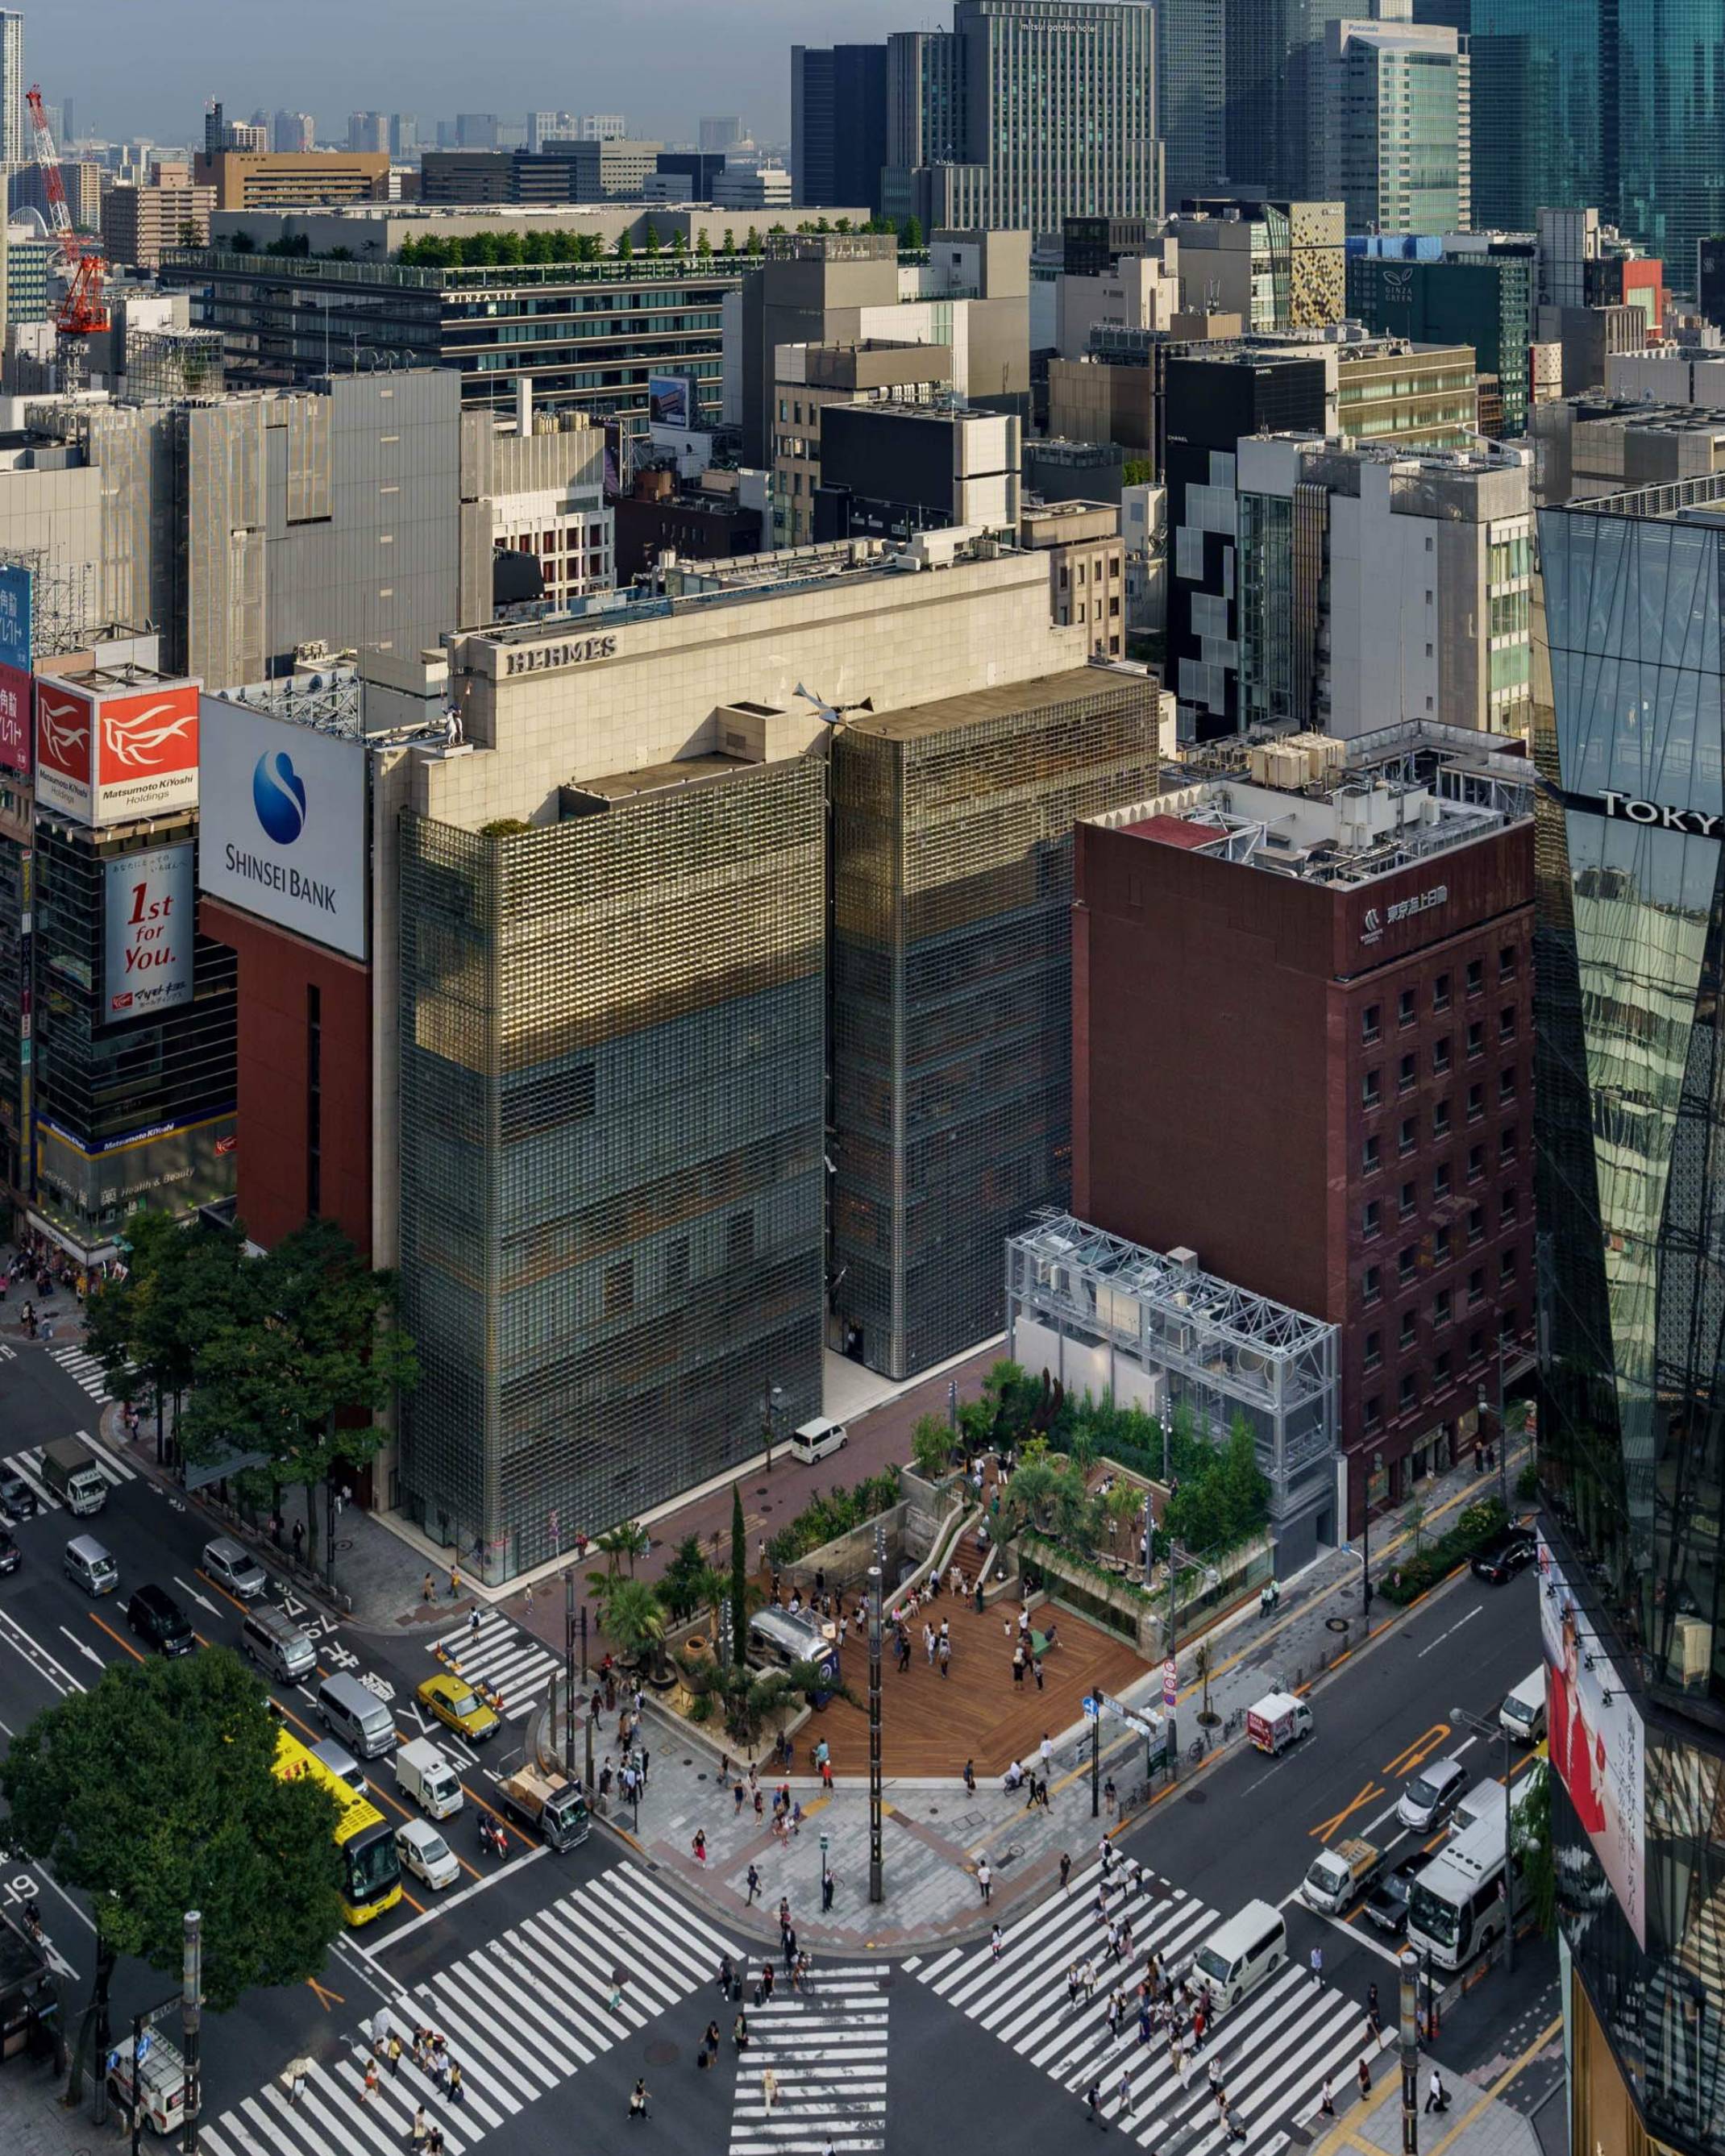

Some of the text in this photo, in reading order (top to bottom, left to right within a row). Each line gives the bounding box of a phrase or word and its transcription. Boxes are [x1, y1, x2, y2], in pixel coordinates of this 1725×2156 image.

[449, 292, 517, 303] GINZA SIX
[1385, 286, 1412, 294] GINZA
[1385, 294, 1412, 303] GREEN
[39, 769, 69, 790] Matsumoto
[103, 774, 193, 800] Matsumoto KiYoshi
[126, 791, 170, 806] Holdings
[226, 843, 336, 915] SHINSEI BANK
[127, 882, 174, 925] 1st
[135, 925, 165, 944] for
[125, 945, 177, 974] You.
[104, 1132, 147, 1151] Matsumoto
[121, 1166, 195, 1198] Health & Beauty
